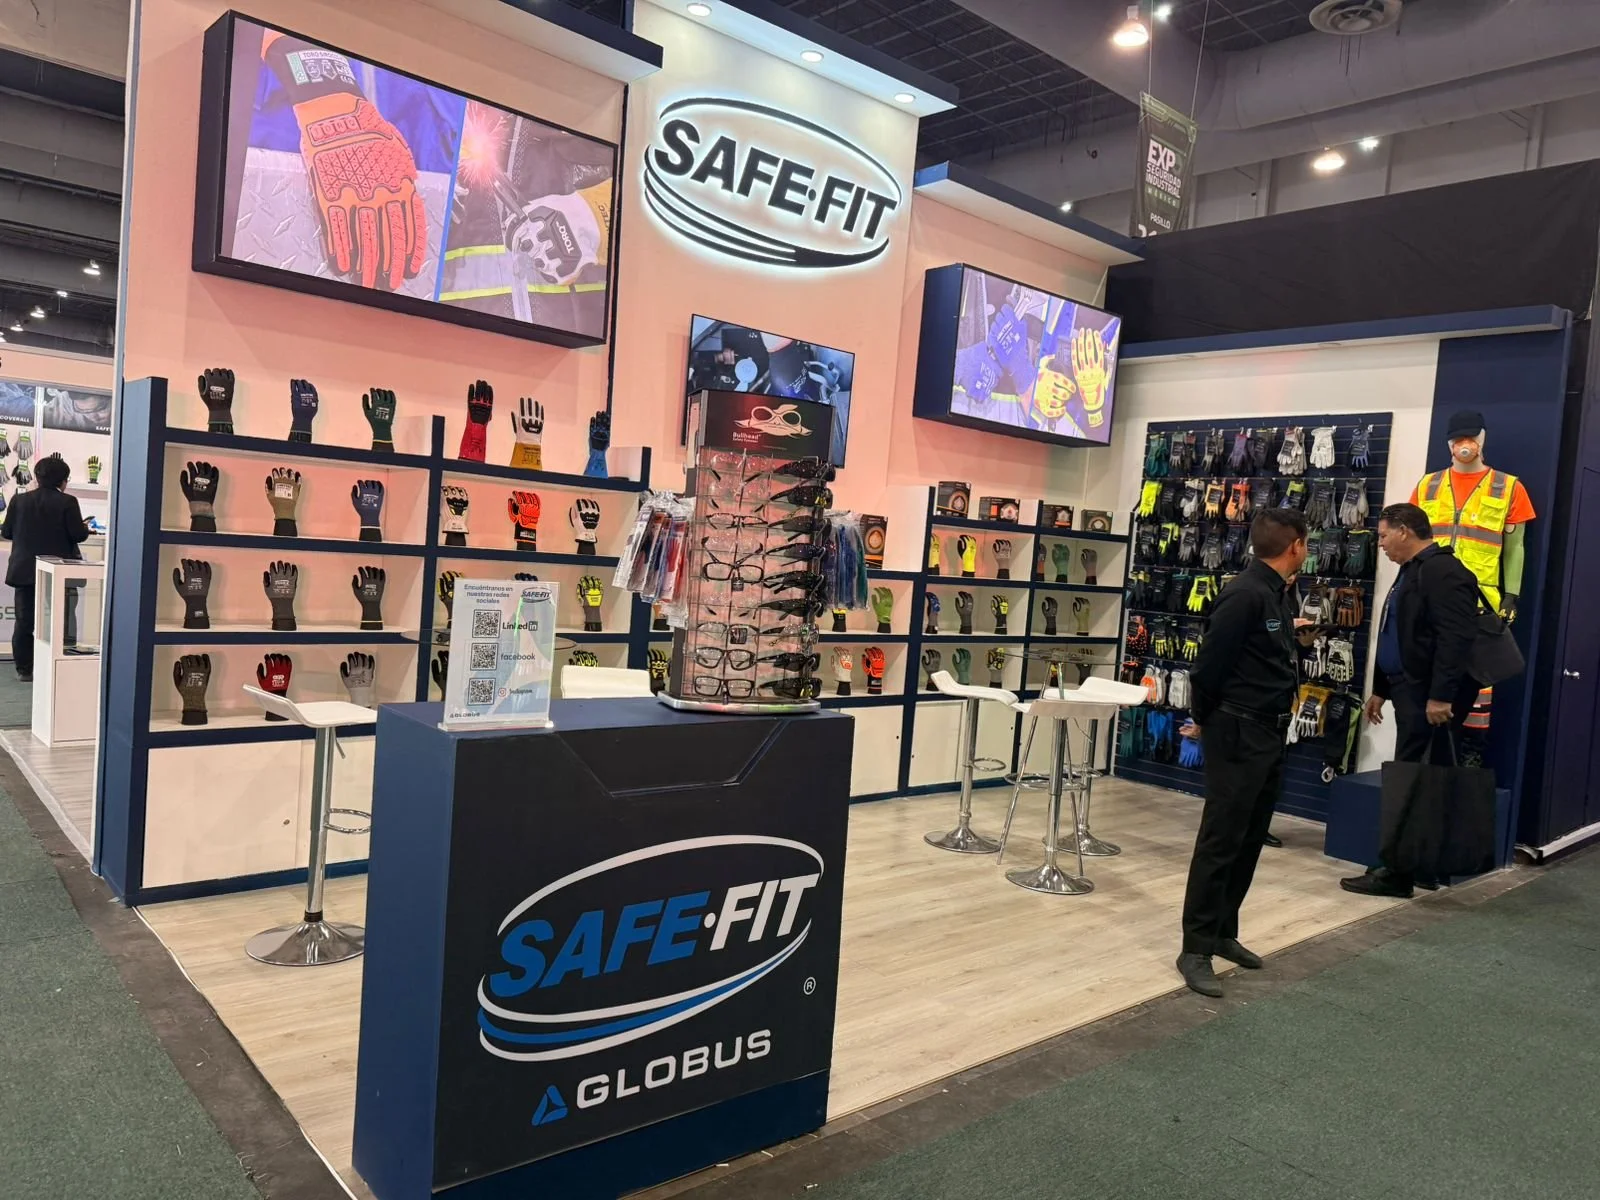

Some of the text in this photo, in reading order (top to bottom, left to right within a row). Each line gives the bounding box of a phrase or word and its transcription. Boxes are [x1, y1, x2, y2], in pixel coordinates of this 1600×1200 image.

[1145, 173, 1181, 198] INDUSTRIAL
[1146, 162, 1182, 188] SEGURIDAD
[1150, 213, 1171, 229] PASILLO
[576, 1029, 772, 1109] GLOBUS
